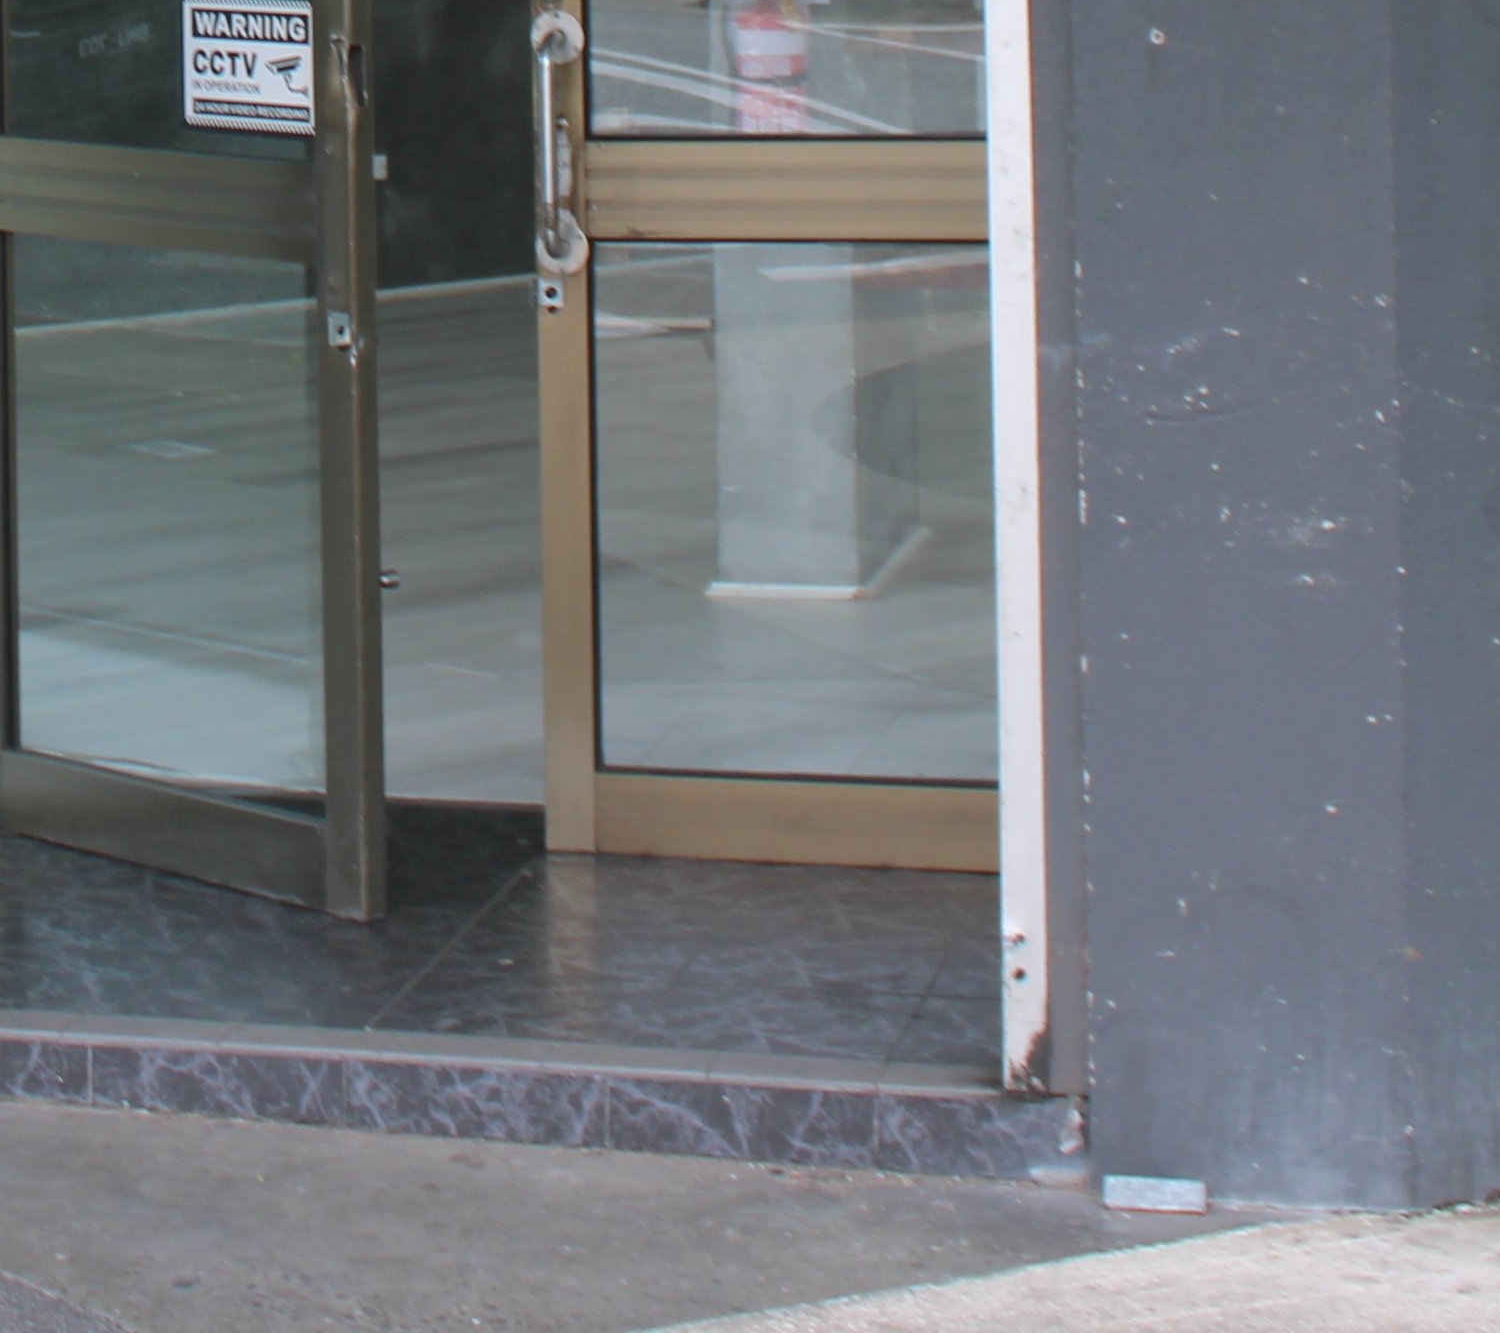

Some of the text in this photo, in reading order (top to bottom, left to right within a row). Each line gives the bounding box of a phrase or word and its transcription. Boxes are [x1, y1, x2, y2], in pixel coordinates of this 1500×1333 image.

[194, 10, 307, 43] WARNING
[193, 48, 258, 80] CCTV
[203, 81, 262, 95] OPERATION
